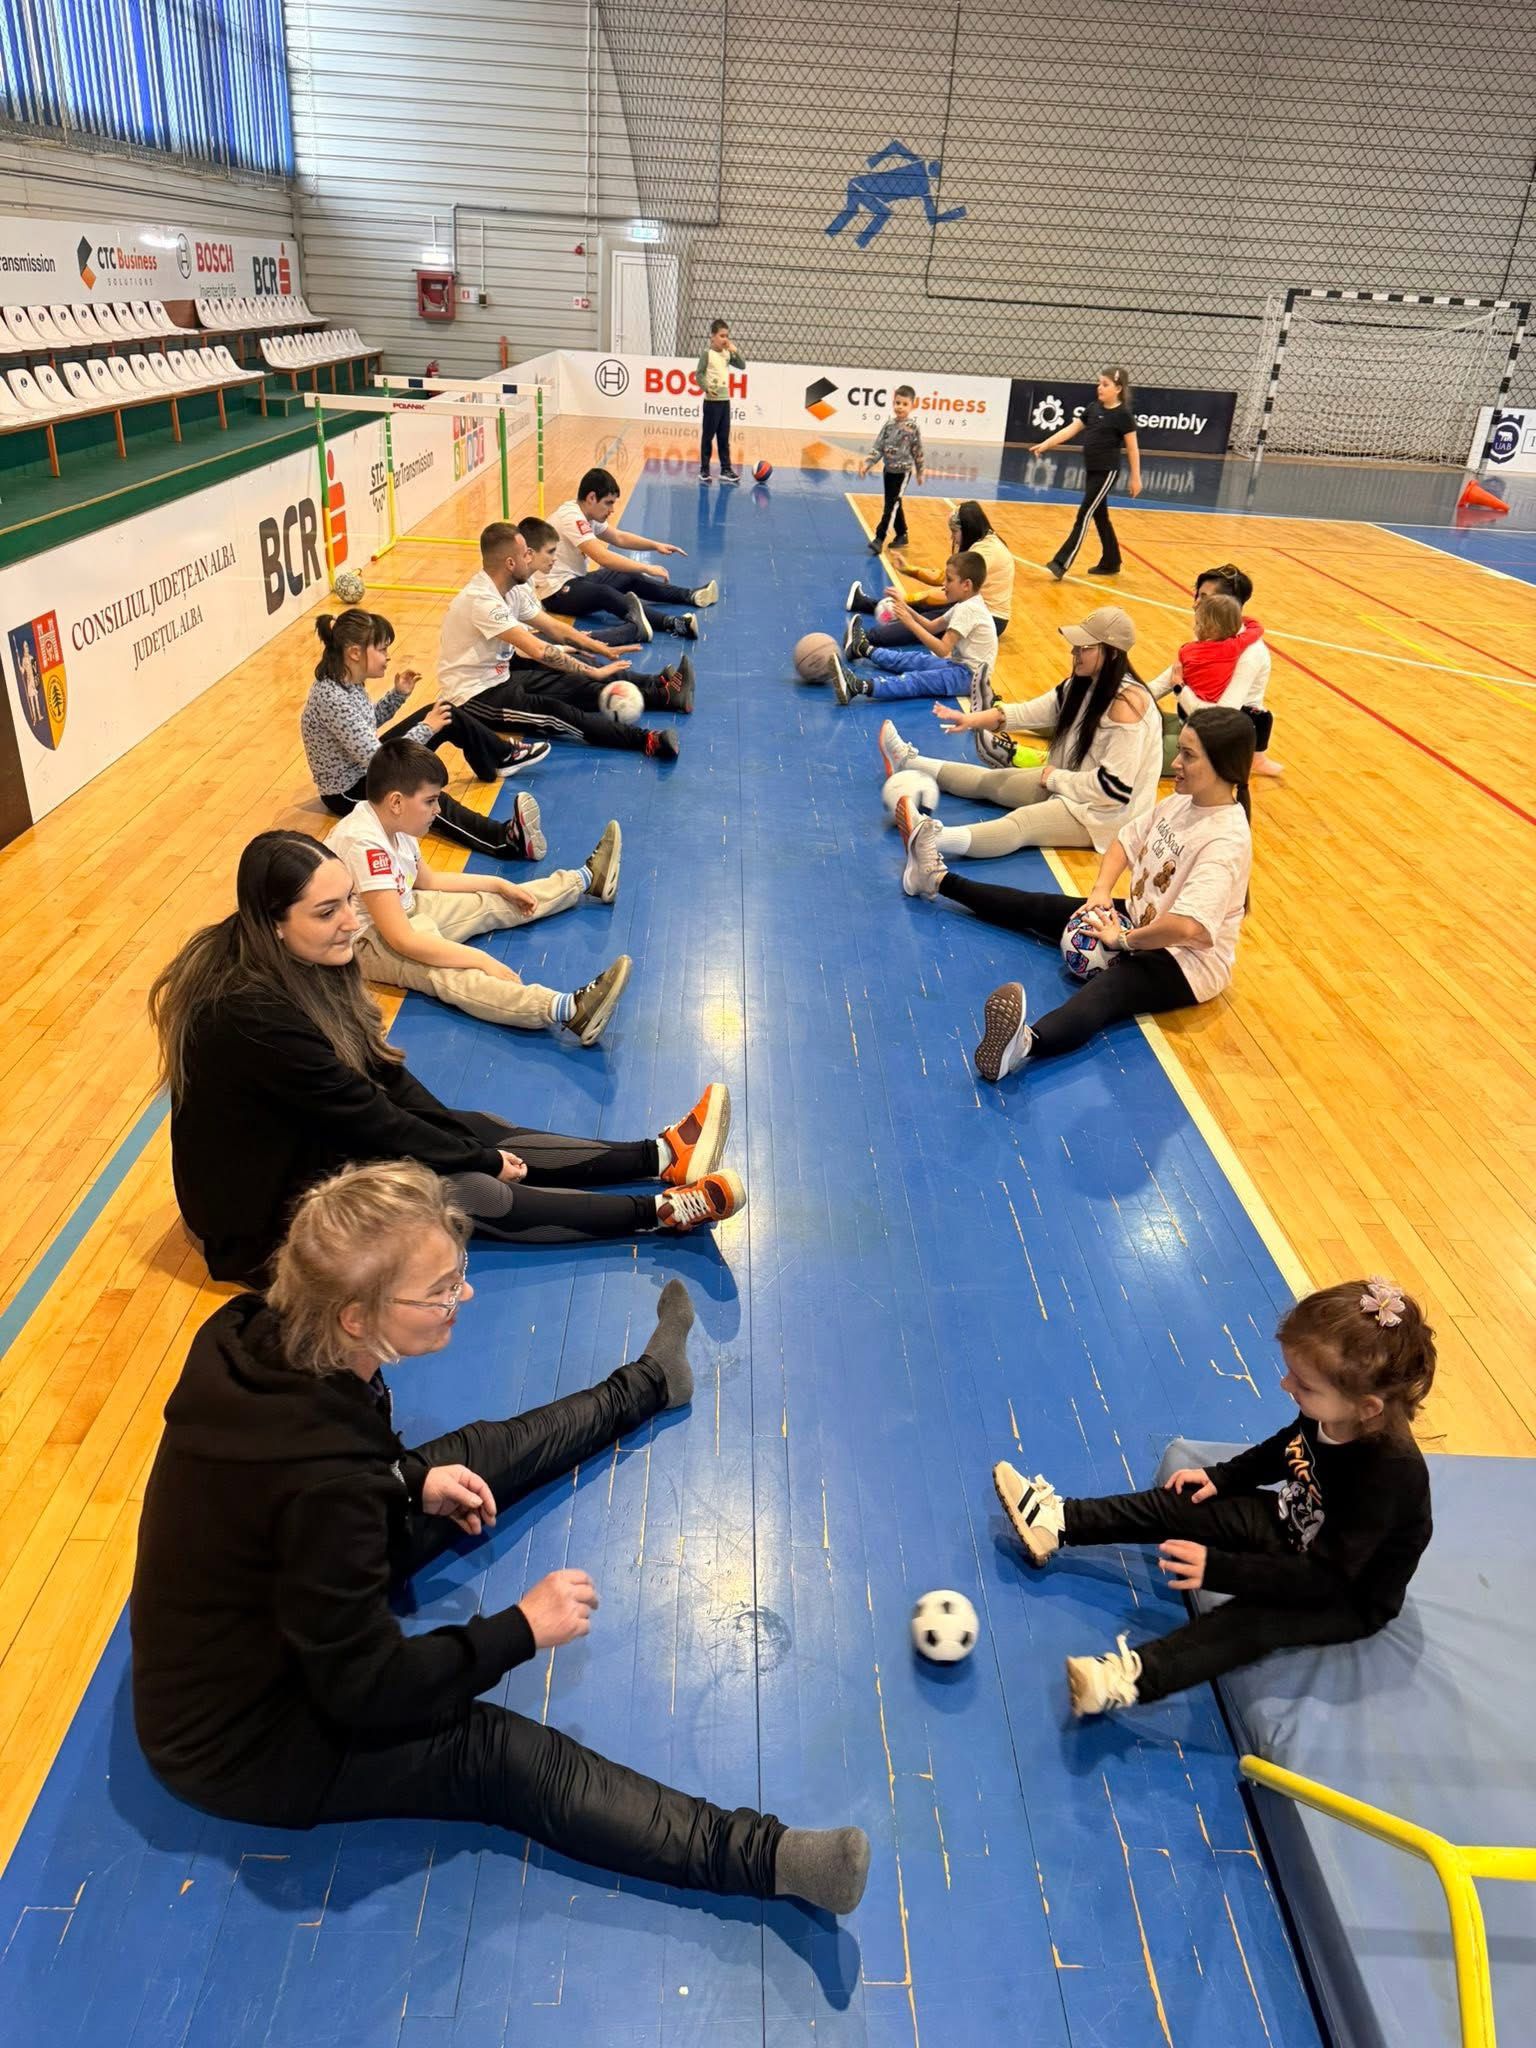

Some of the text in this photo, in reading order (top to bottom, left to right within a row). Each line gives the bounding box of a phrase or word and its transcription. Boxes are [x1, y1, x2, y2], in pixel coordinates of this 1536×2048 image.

[97, 246, 158, 270] CTC Business
[195, 242, 234, 273] BOSCH
[252, 256, 278, 295] BCR
[645, 367, 748, 399] BOSH
[644, 402, 746, 421] Invented ife
[847, 387, 987, 414] CTC usiness
[371, 461, 385, 487] STC
[259, 497, 322, 615] BCR
[71, 588, 150, 651] CONSILIUL
[210, 542, 237, 576] ALBA
[180, 604, 204, 635] ALBA
